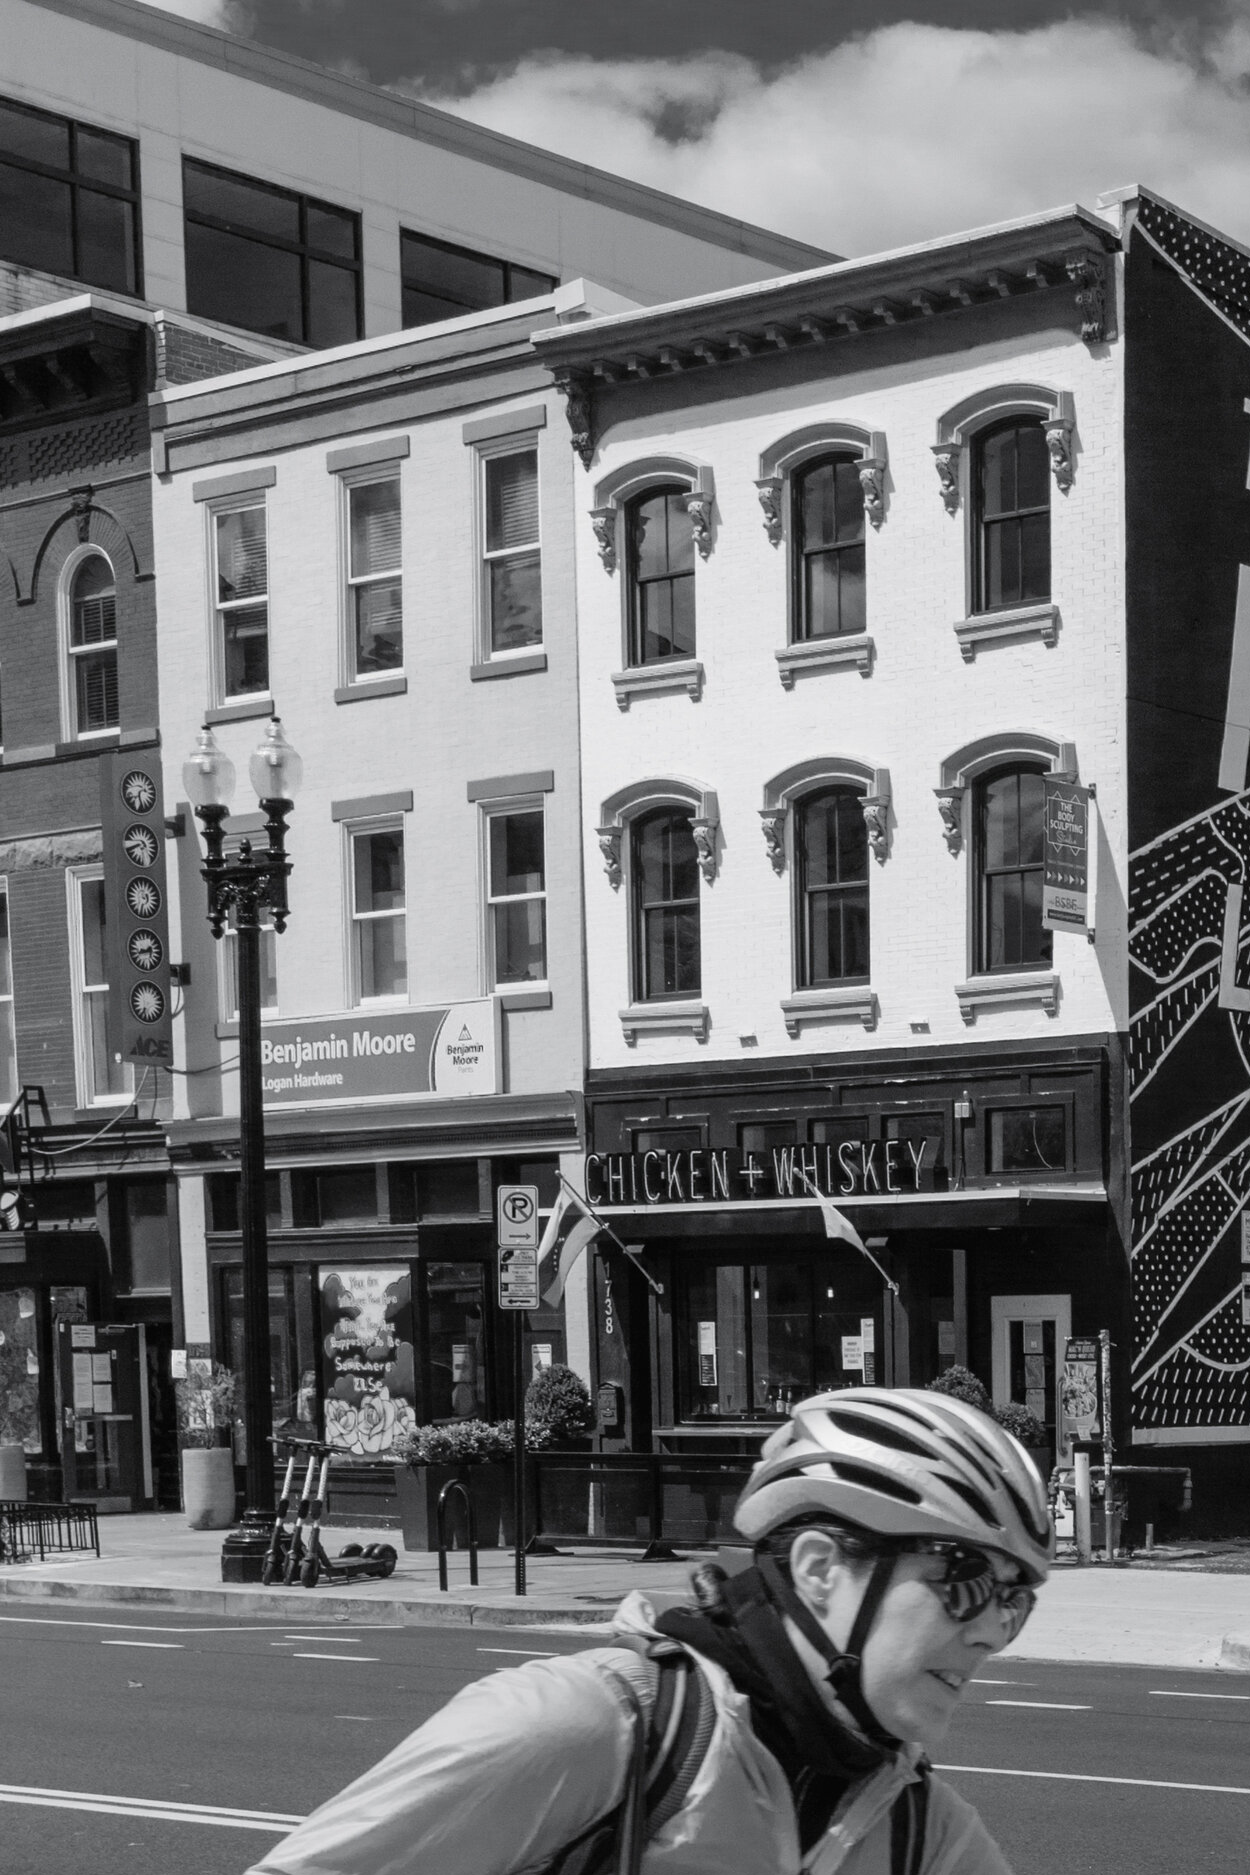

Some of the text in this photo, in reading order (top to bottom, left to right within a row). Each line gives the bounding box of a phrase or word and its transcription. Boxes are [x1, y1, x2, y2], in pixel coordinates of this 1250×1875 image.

[1057, 810, 1076, 823] BODY
[1060, 802, 1072, 813] THE
[1050, 818, 1083, 835] SCULPTING
[130, 1033, 170, 1058] ACE
[261, 1031, 416, 1069] Benjamin Moore
[447, 1043, 484, 1057] Benjamin
[453, 1054, 479, 1066] Moore
[262, 1071, 343, 1092] Logan Hardware
[584, 1150, 730, 1204] CHICKEN
[773, 1140, 926, 1197] WHISKEY
[604, 1261, 613, 1334] 1738
